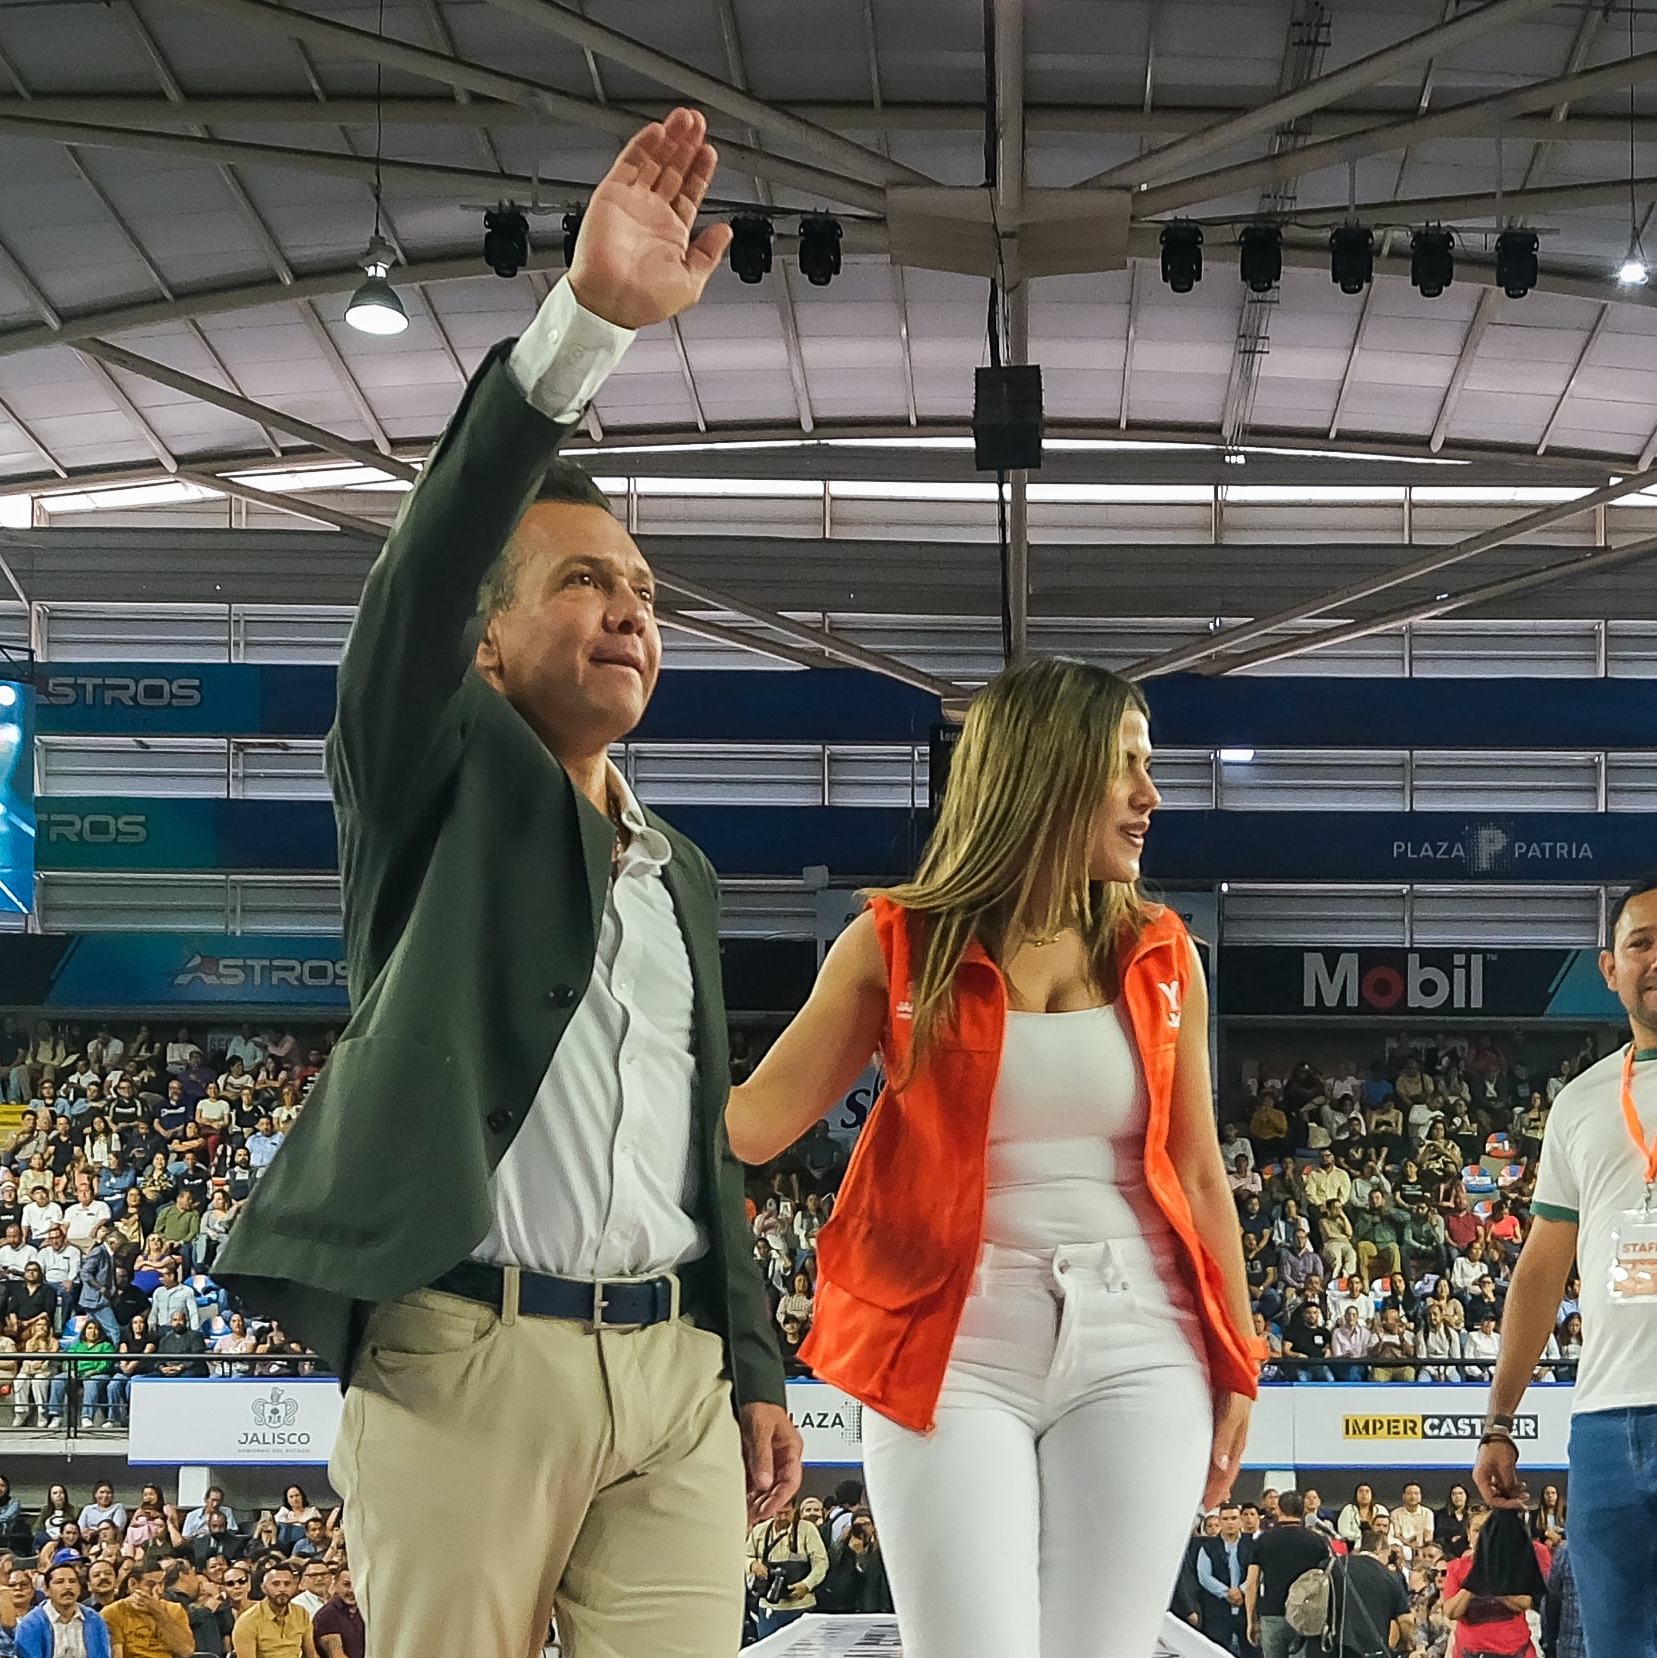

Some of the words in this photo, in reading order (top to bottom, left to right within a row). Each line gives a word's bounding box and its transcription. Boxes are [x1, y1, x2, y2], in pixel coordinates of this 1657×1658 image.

[1393, 841, 1464, 860] PLAZA
[1514, 842, 1594, 860] PATRIA
[1303, 952, 1482, 1008] Mobil
[789, 1412, 845, 1429] LAZA
[237, 1432, 311, 1445] JALISCO
